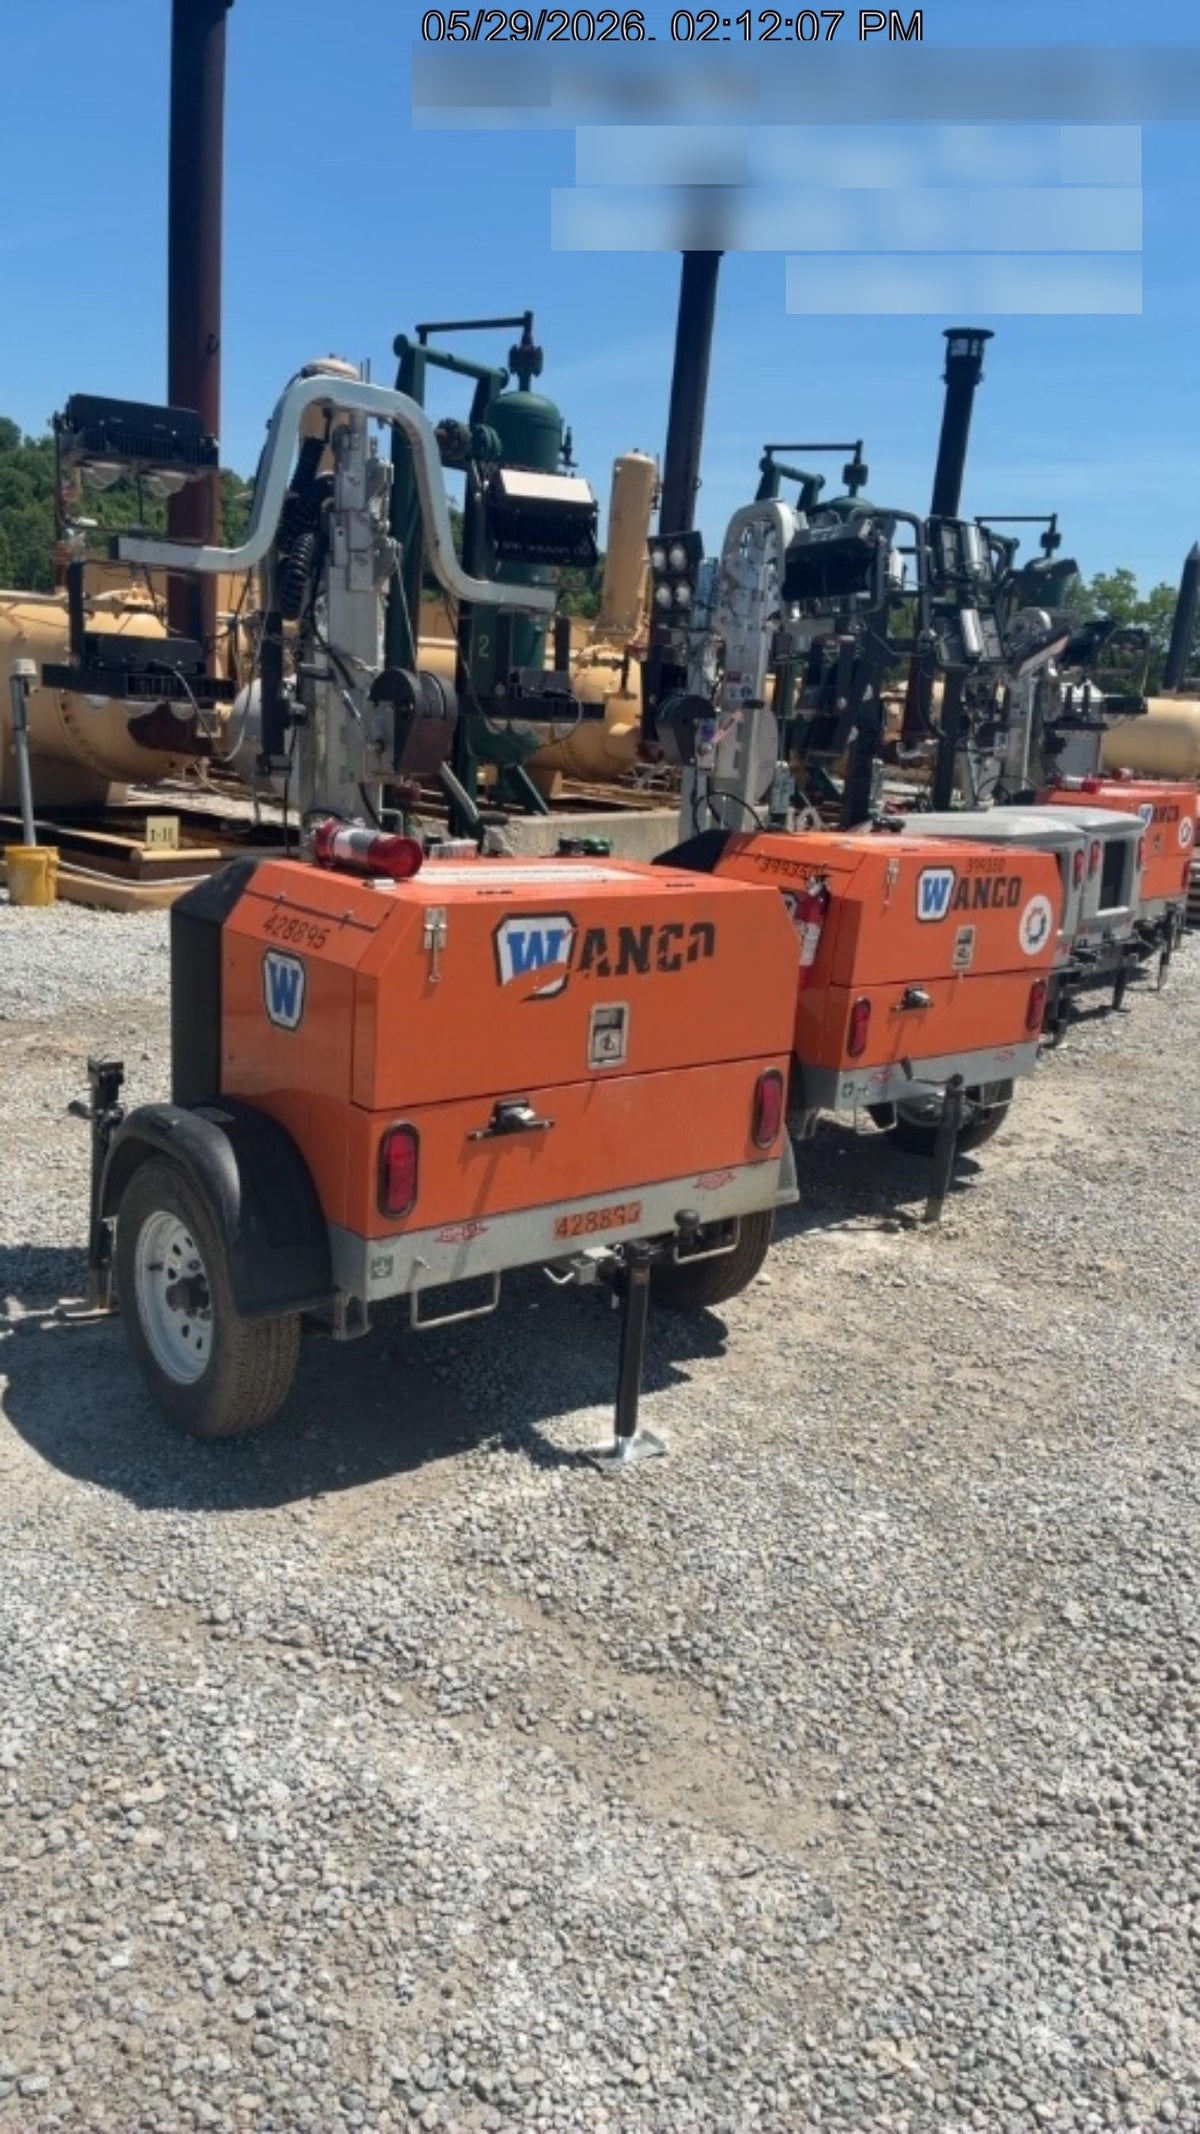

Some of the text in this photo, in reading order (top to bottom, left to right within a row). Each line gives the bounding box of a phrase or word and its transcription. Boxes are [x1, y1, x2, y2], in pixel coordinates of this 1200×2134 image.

[478, 635, 490, 658] 2
[921, 875, 1022, 912] WANCO
[262, 913, 331, 949] 428895
[267, 961, 301, 1018] W
